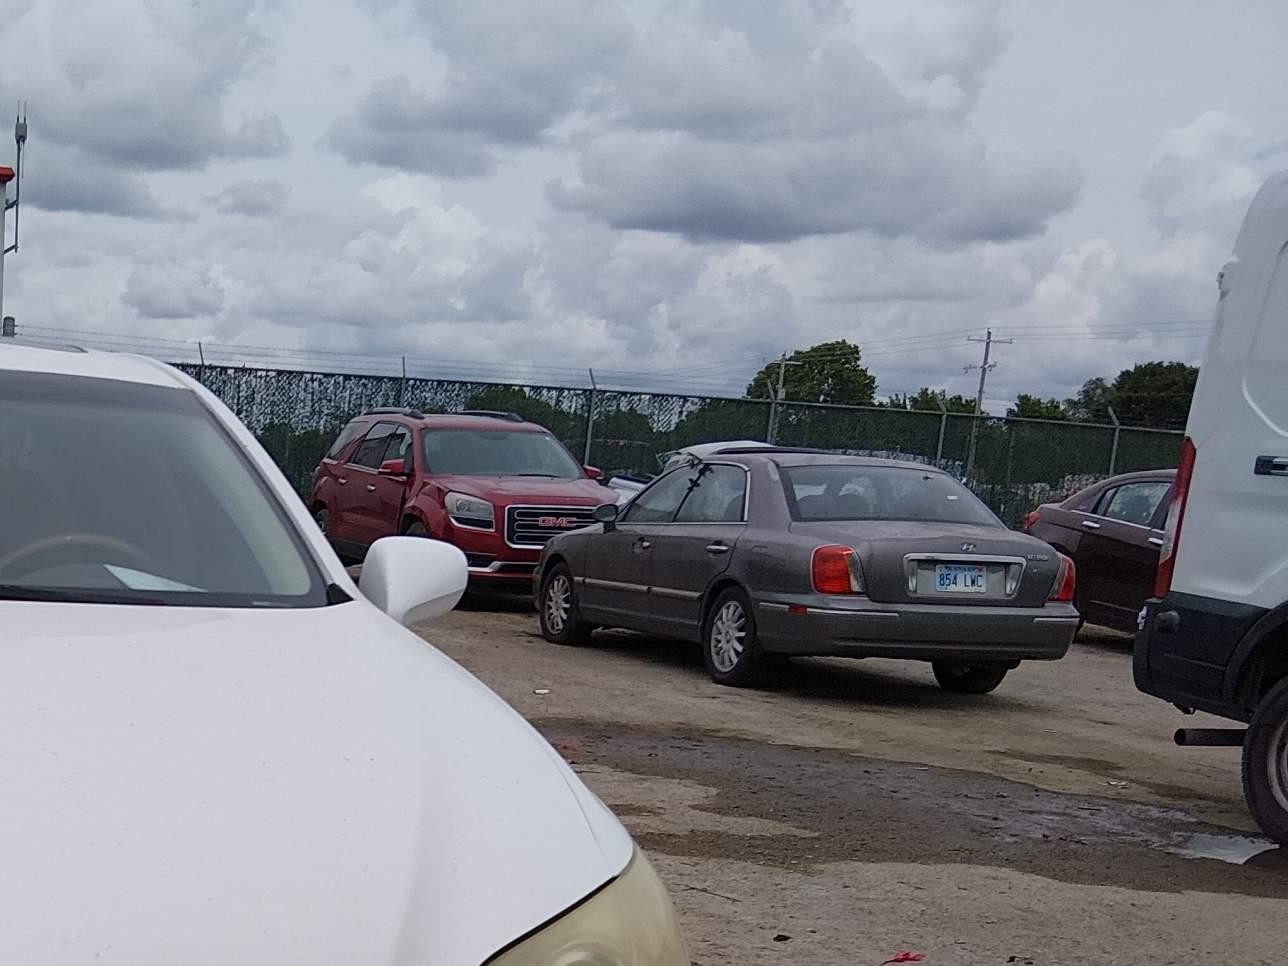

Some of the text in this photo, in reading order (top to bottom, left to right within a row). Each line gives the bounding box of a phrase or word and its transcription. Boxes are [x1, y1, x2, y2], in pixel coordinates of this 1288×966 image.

[538, 516, 577, 528] GMC
[939, 573, 983, 588] 854 LWC
